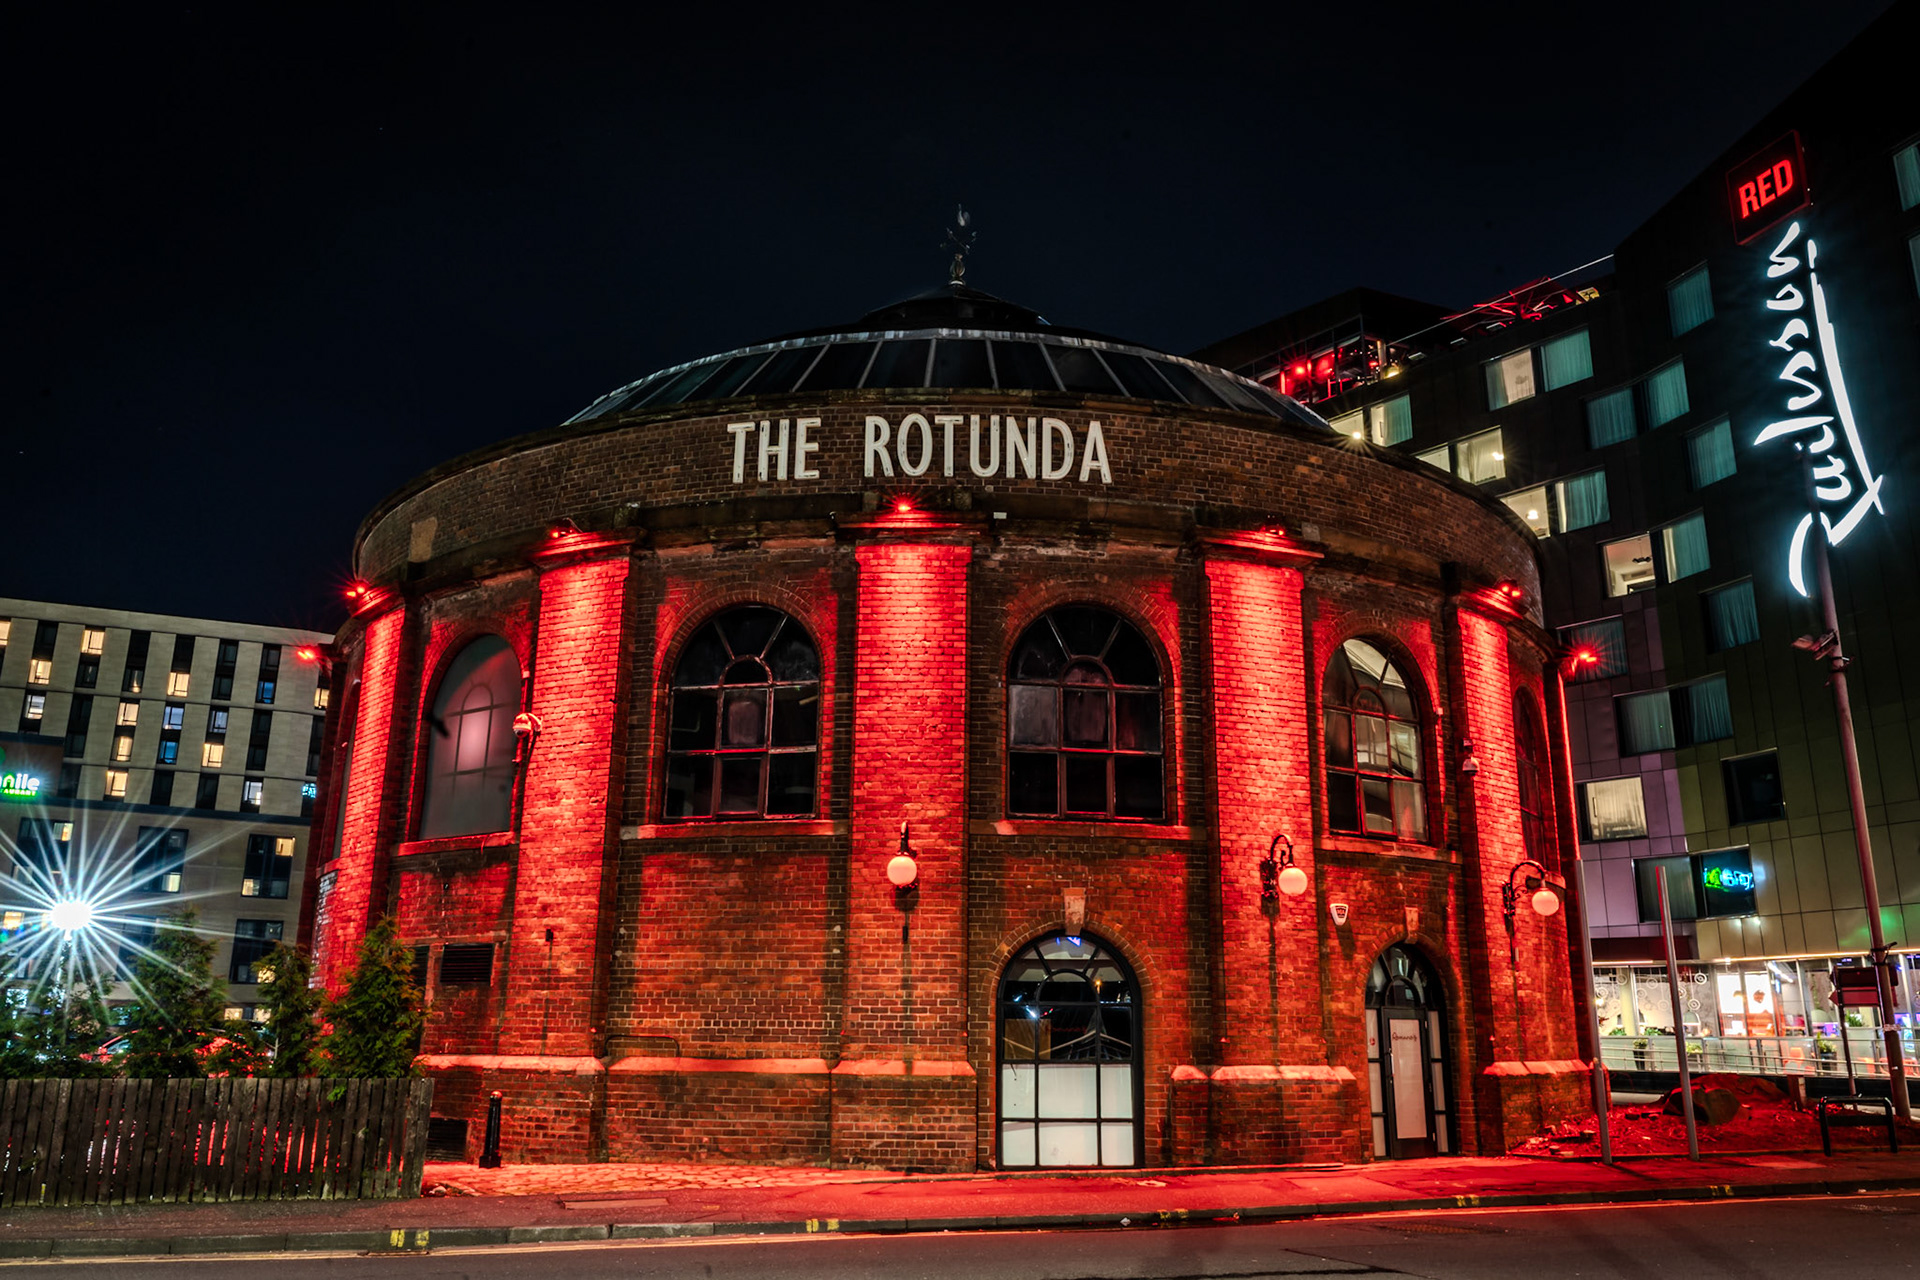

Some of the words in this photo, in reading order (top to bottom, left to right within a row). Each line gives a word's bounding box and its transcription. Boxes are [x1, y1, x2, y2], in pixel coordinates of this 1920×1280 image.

[1738, 158, 1794, 219] RED
[726, 416, 823, 484] THE
[863, 412, 1113, 484] ROTUNDA
[0, 773, 40, 790] nile
